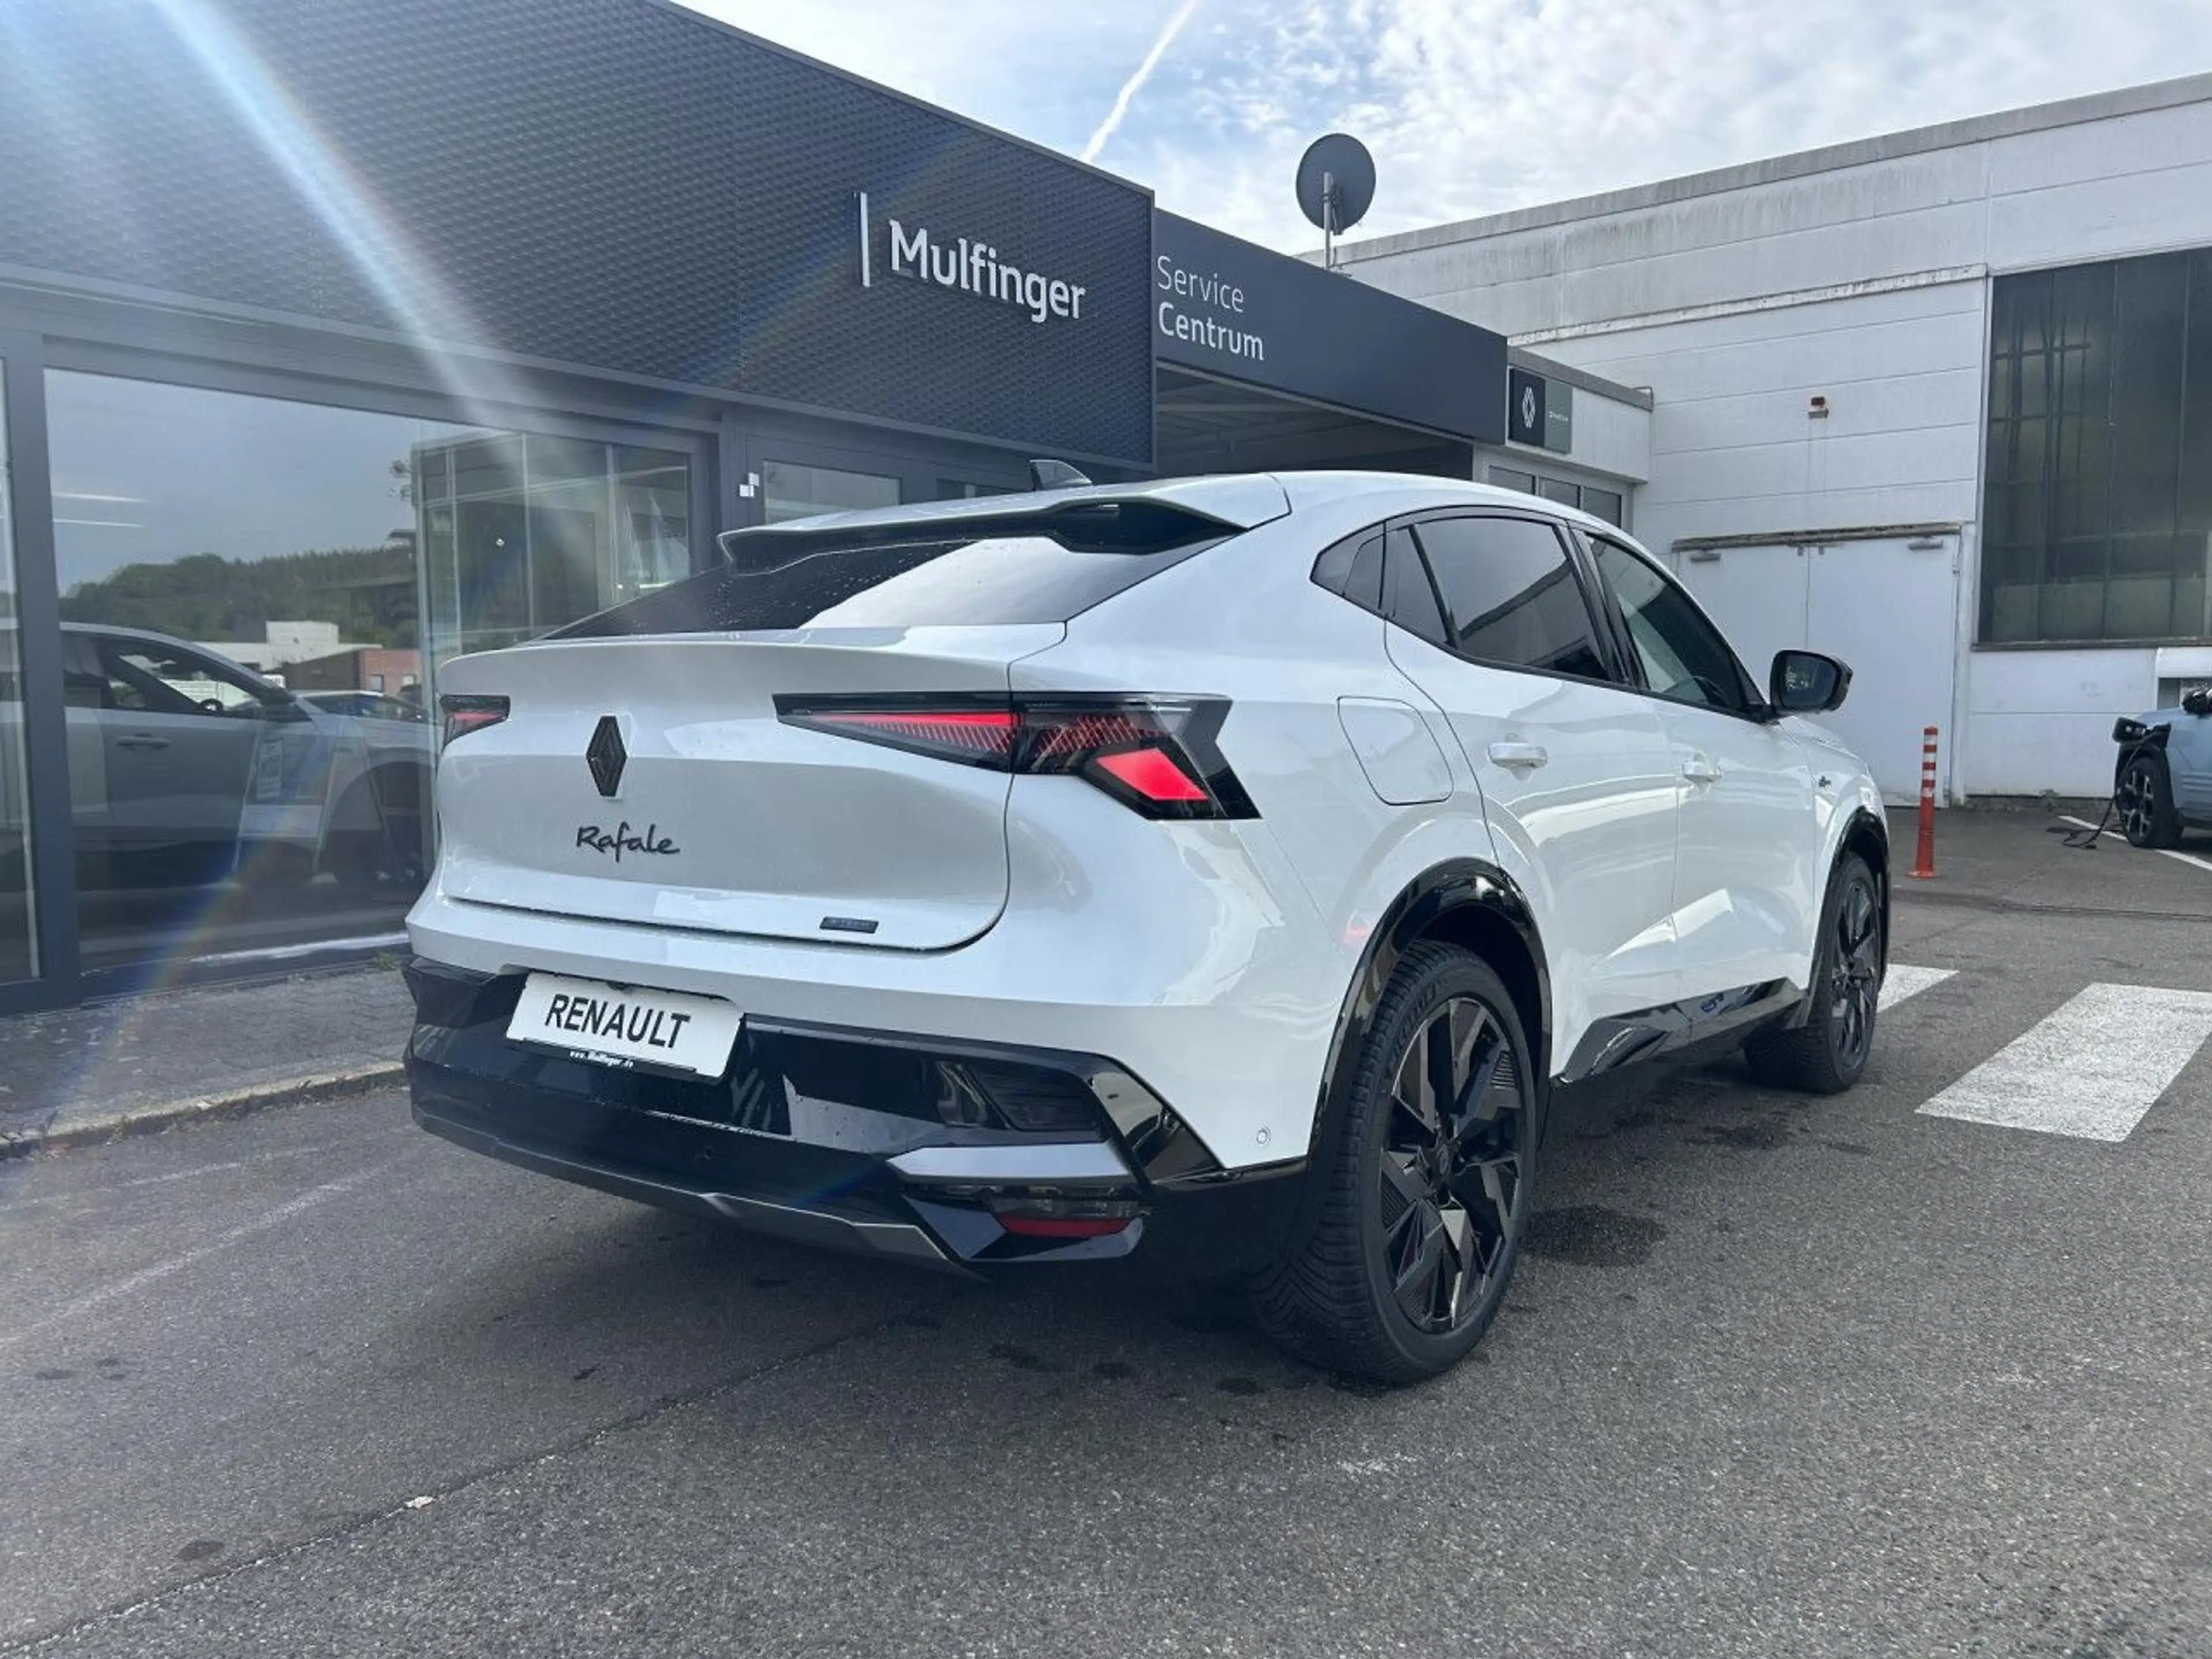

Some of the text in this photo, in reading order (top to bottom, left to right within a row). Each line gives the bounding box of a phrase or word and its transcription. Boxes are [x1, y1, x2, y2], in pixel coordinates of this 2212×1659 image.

[889, 219, 1086, 323] Mulfinger
[1157, 255, 1245, 313] Service
[1158, 301, 1264, 361] Centrum
[576, 820, 681, 863] Rafale
[544, 993, 691, 1050] RENAULT
